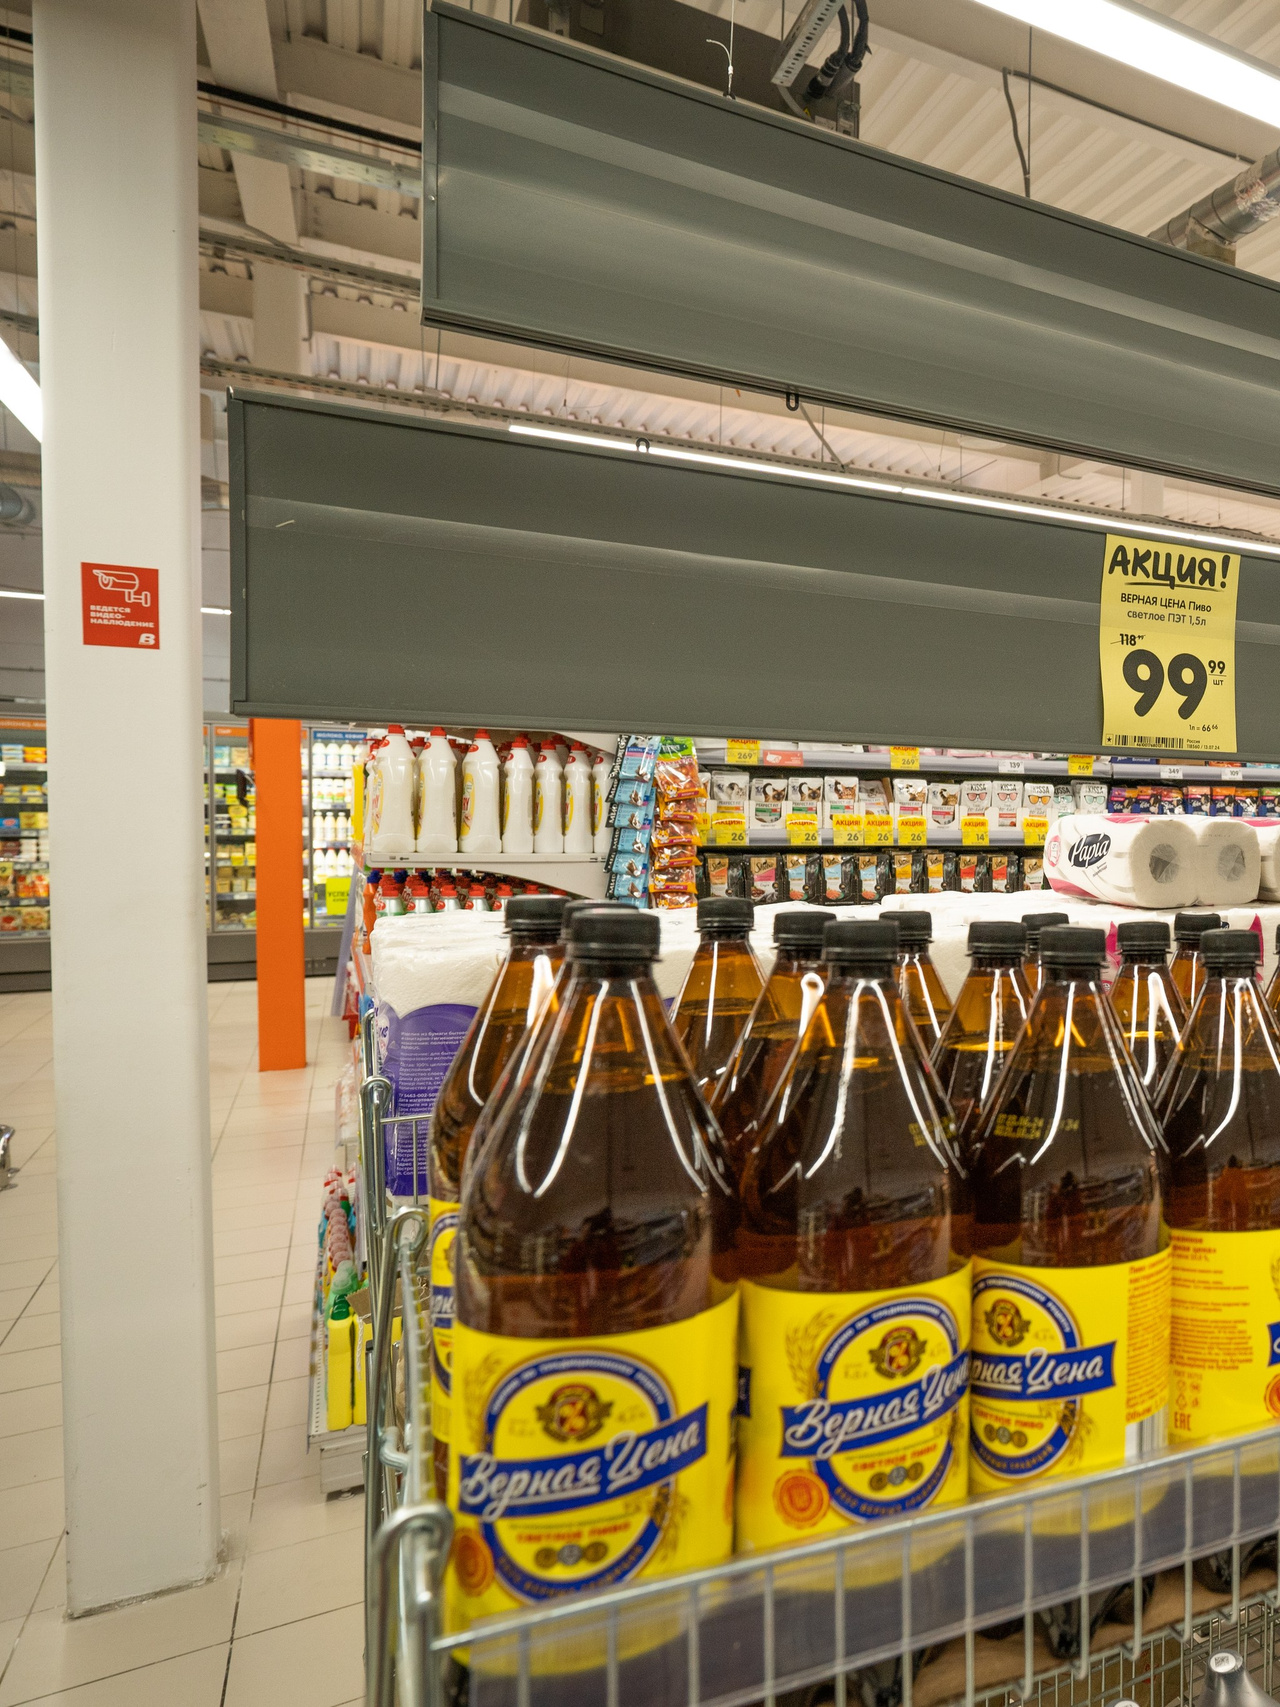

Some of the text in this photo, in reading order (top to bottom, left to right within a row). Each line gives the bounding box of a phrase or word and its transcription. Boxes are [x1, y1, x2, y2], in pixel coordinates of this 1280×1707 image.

[1109, 545, 1231, 590] АКЦИЯ!
[1121, 593, 1211, 612] ВЕРНАЯ ЦЕНА Пиво
[90, 605, 131, 613] ВЕДЕТСЯ
[90, 611, 125, 619] ВИДЕО-
[1127, 610, 1206, 626] светлое ПЭТ 1,5л
[90, 618, 155, 628] НАБЛЮДЕНИЕ
[1119, 633, 1137, 646] 118
[1208, 660, 1226, 675] 99
[1123, 649, 1208, 720] 99
[737, 752, 752, 760] 269
[902, 758, 915, 766] 269
[835, 819, 861, 827] АКЦИЯ!
[901, 820, 925, 828] АКЦИЯ!
[964, 820, 987, 828] АКЦИЯ!
[731, 833, 744, 841] 26
[805, 833, 817, 841] 26
[847, 833, 859, 841] 26
[878, 834, 889, 842] 26
[911, 833, 922, 842] 26
[976, 833, 985, 842] 14
[1025, 1347, 1104, 1395] Цена
[785, 1398, 919, 1460] Верная
[461, 1420, 701, 1523] Верная Цена
